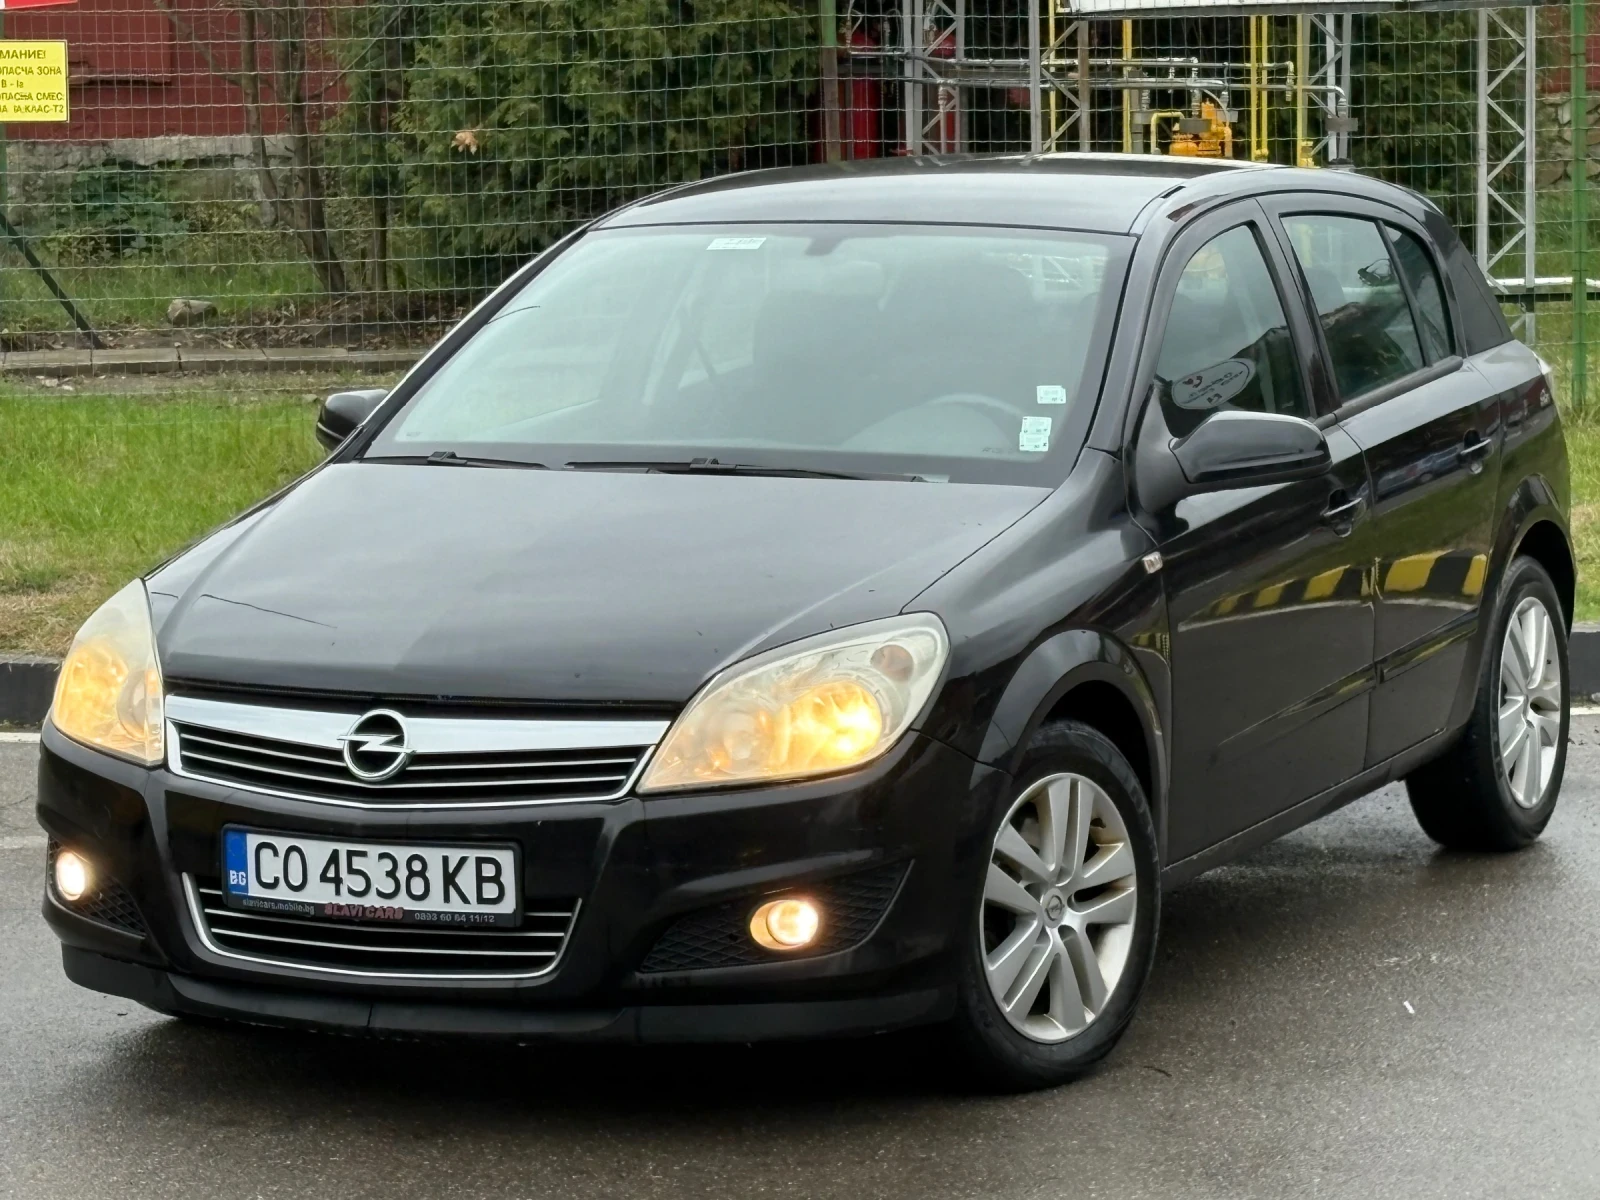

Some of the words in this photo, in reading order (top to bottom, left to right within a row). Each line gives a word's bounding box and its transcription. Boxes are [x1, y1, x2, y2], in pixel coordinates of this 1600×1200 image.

[37, 66, 62, 75] ЗОНА
[229, 870, 247, 886] BG
[254, 841, 308, 893] CO
[319, 849, 431, 901] 4538
[441, 855, 505, 905] KB
[324, 902, 363, 917] SLAVI
[365, 905, 404, 920] CARS
